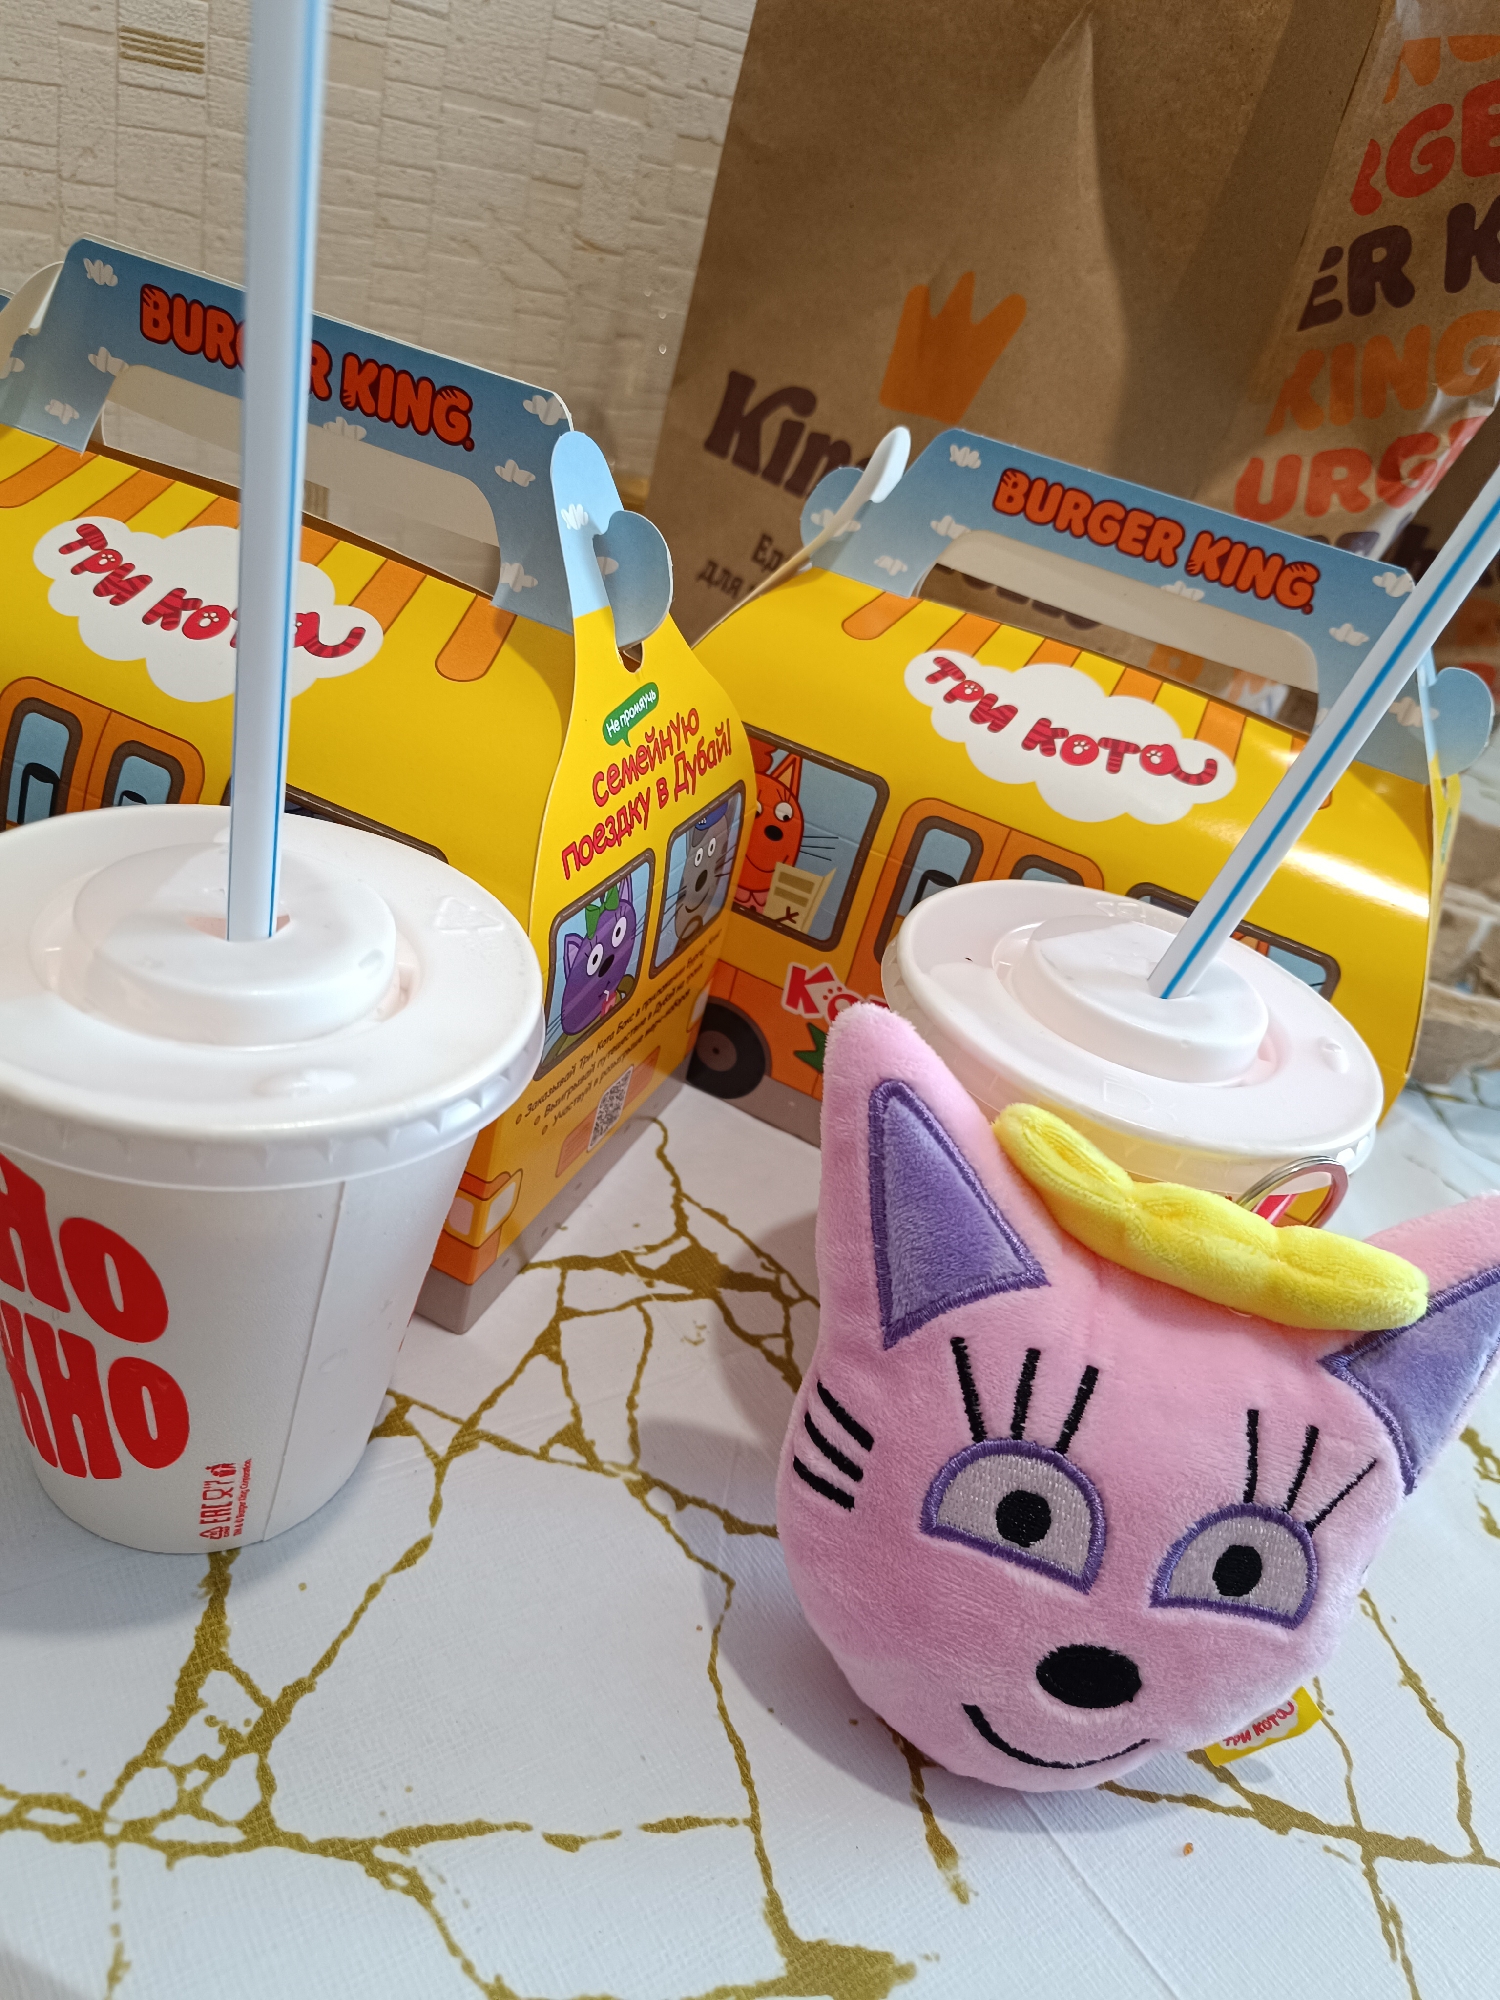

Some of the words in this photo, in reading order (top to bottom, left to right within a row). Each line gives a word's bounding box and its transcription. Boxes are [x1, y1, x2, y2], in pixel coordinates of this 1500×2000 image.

[139, 283, 333, 402] BURR
[704, 370, 871, 500] Kin
[991, 467, 1186, 568] BURGER
[58, 523, 154, 606] ТРИ
[141, 587, 367, 658] КОА
[605, 718, 621, 738] Не
[619, 689, 658, 728] промяучь
[924, 656, 1019, 733] ТРИ
[561, 786, 651, 881] поездку
[656, 776, 670, 810] в
[673, 717, 732, 803] Дубай!
[592, 707, 700, 808] семейную
[1223, 1729, 1252, 1747] ТРИ
